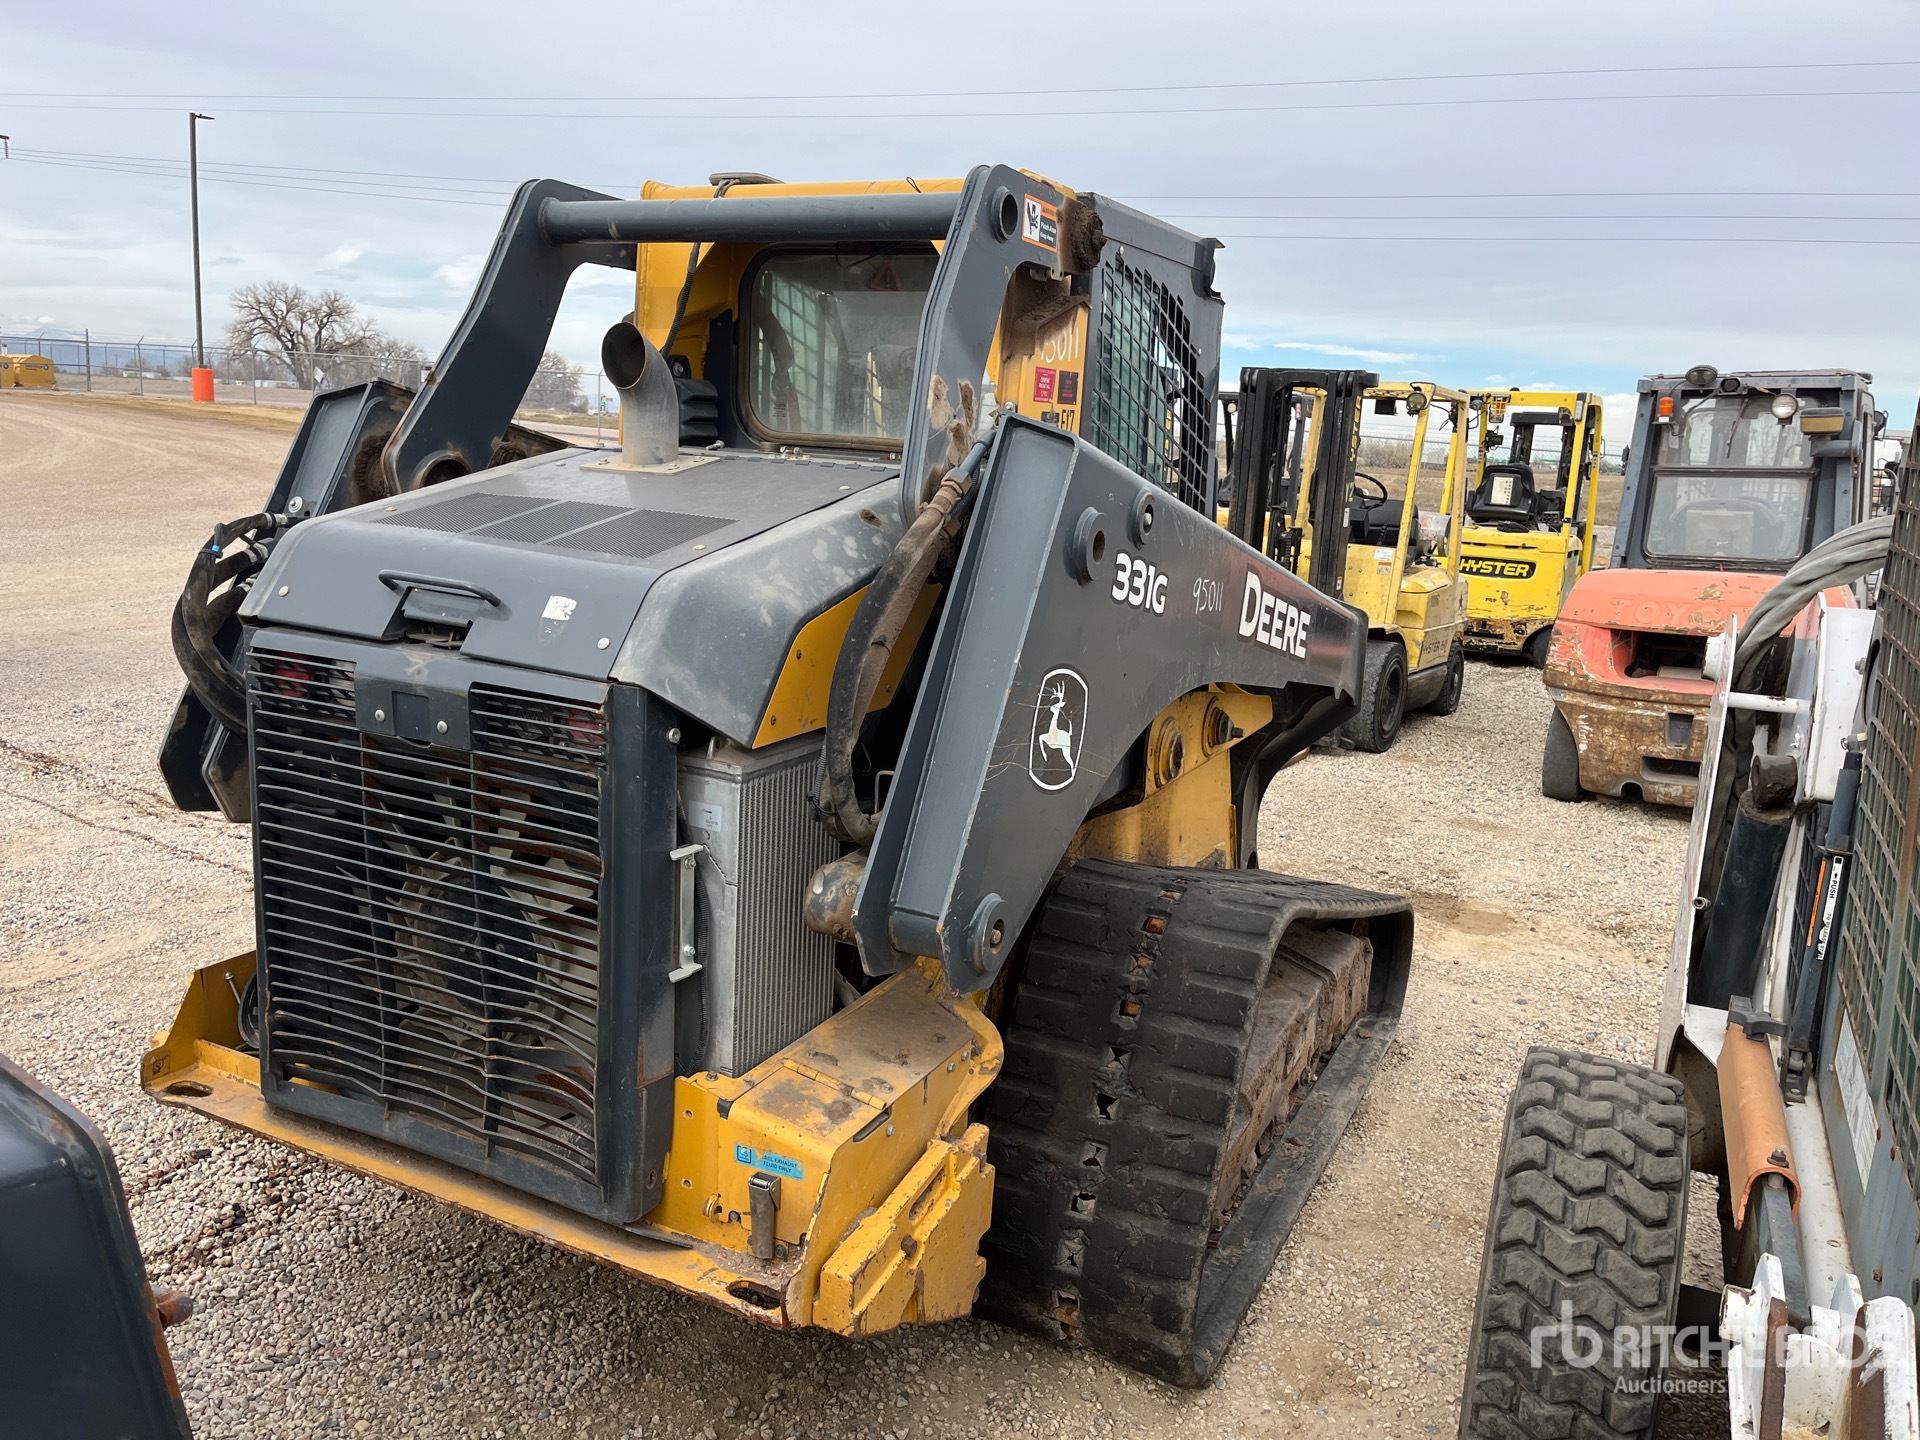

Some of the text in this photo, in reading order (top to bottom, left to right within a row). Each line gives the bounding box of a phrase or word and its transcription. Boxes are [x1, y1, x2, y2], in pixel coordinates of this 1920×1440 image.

[1040, 327, 1079, 363] 5011
[1459, 558, 1530, 577] HYSTER
[1112, 552, 1168, 614] 331G
[1192, 577, 1224, 615] 95011
[1238, 570, 1312, 660] DEERE
[1828, 879, 1838, 899] PUSH
[762, 1160, 792, 1173] FLUID ONLY
[774, 1157, 798, 1168] EXHAUST
